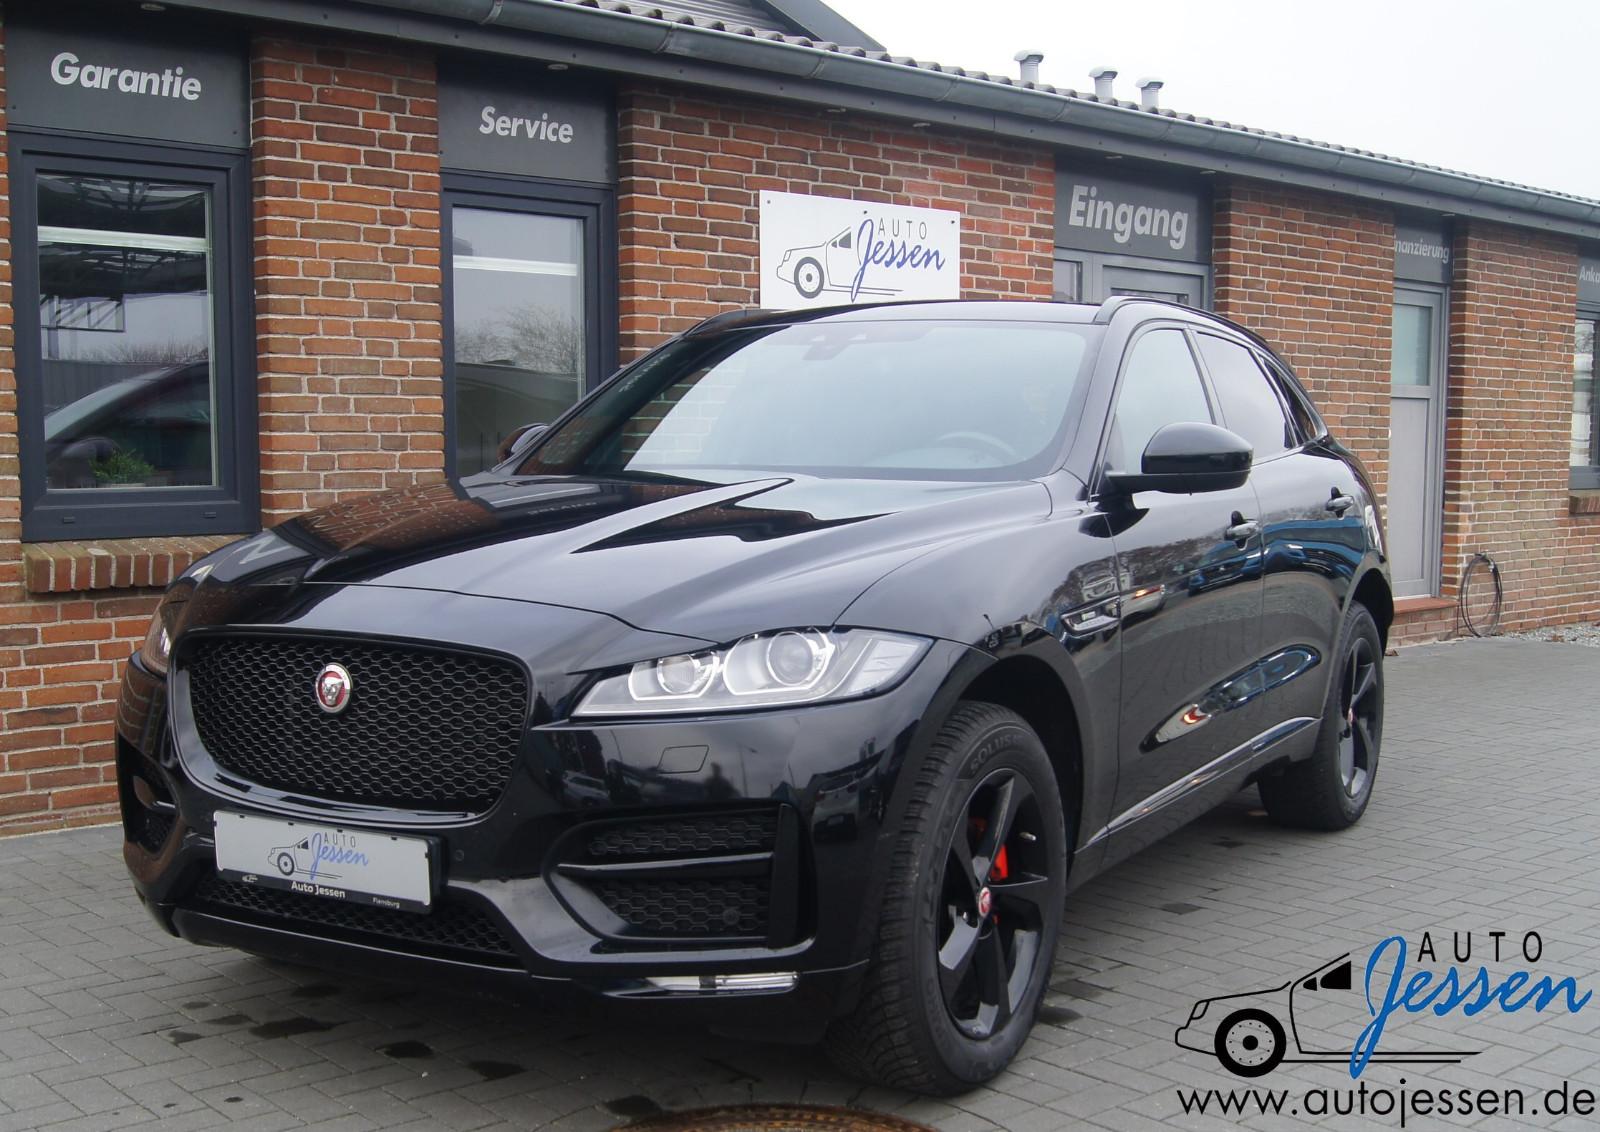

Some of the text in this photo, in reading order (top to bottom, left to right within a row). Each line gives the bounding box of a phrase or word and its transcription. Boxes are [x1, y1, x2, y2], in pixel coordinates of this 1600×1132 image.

[50, 51, 203, 103] Garantie
[479, 105, 574, 145] Service
[876, 219, 929, 241] AUTO
[1068, 184, 1189, 250] Eingang
[850, 218, 946, 303] Jessen
[310, 832, 369, 880] Jessen
[324, 832, 356, 848] AUTO
[291, 881, 346, 899] Auto Jessen
